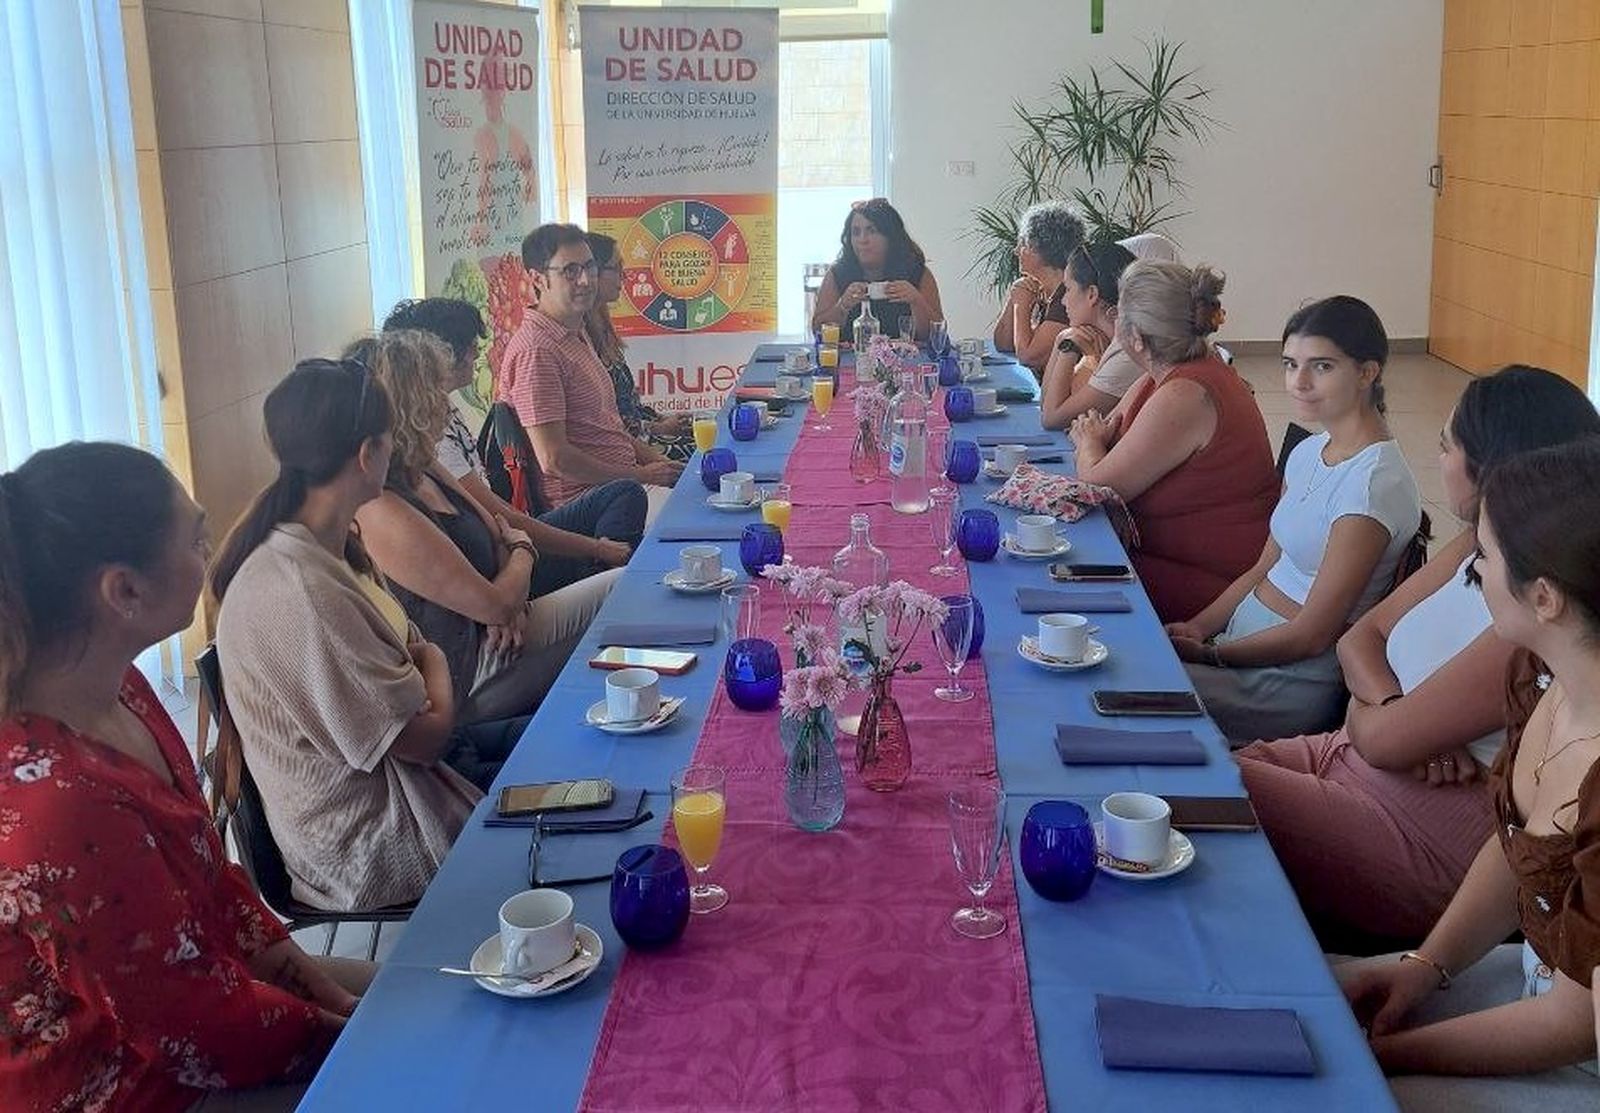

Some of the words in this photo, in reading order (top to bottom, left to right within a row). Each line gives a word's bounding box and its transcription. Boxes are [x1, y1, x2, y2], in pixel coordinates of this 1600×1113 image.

[435, 22, 523, 58] UNIDAD
[619, 27, 743, 52] UNIDAD
[424, 57, 457, 89] DE
[463, 60, 533, 91] SALUD
[605, 57, 647, 81] DE
[657, 57, 758, 82] SALUD
[687, 91, 707, 105] DE
[709, 91, 757, 105] SALUD
[671, 279, 698, 287] SALUD
[695, 396, 710, 409] de
